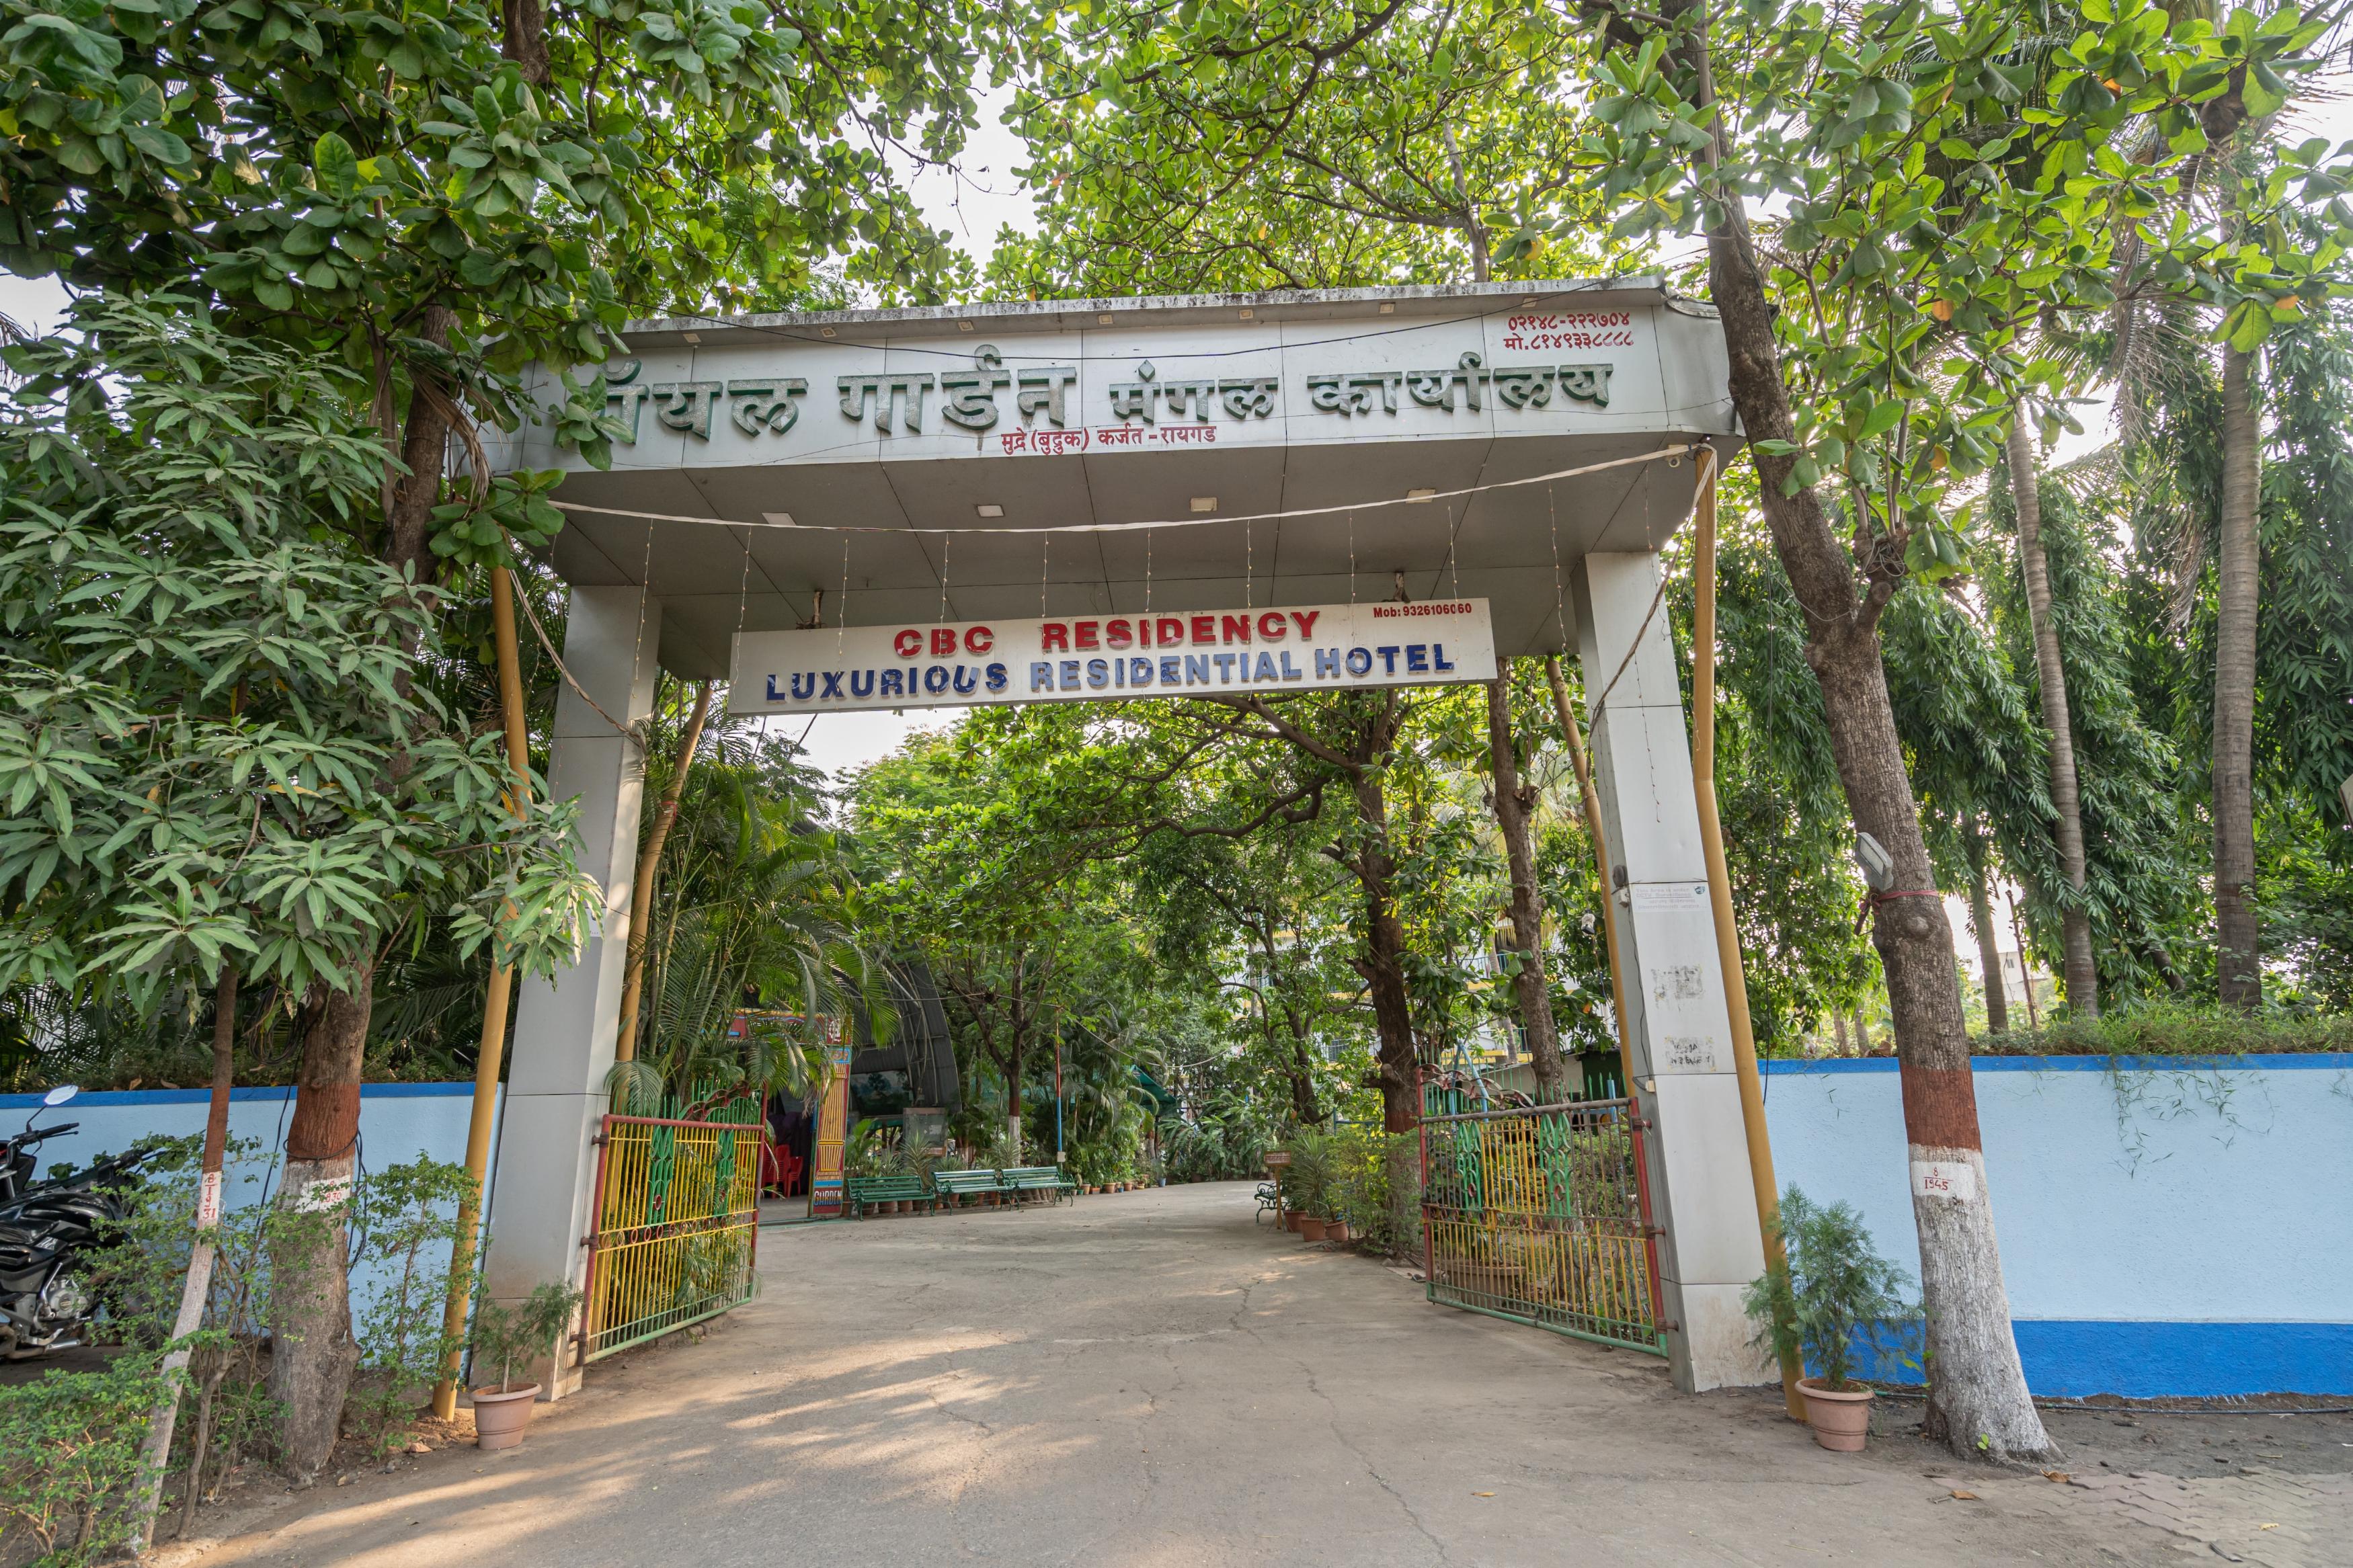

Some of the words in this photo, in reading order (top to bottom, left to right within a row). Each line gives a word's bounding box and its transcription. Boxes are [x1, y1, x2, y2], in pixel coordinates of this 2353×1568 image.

[581, 359, 807, 445] ॉयल
[837, 344, 1077, 434] गार्डन
[1109, 359, 1279, 425] मंगल
[1307, 352, 1613, 417] कार्यालय
[1001, 427, 1027, 455] मुद्रे
[1097, 422, 1144, 445] कर्जत
[893, 626, 994, 659] CBC
[1043, 610, 1320, 654] RESIDENCY
[766, 662, 1008, 704] LUXURIOUS
[1030, 650, 1302, 693] RESIDENTIAL
[1316, 643, 1455, 679] HOTEL
[814, 1190, 842, 1205] GARDEN
